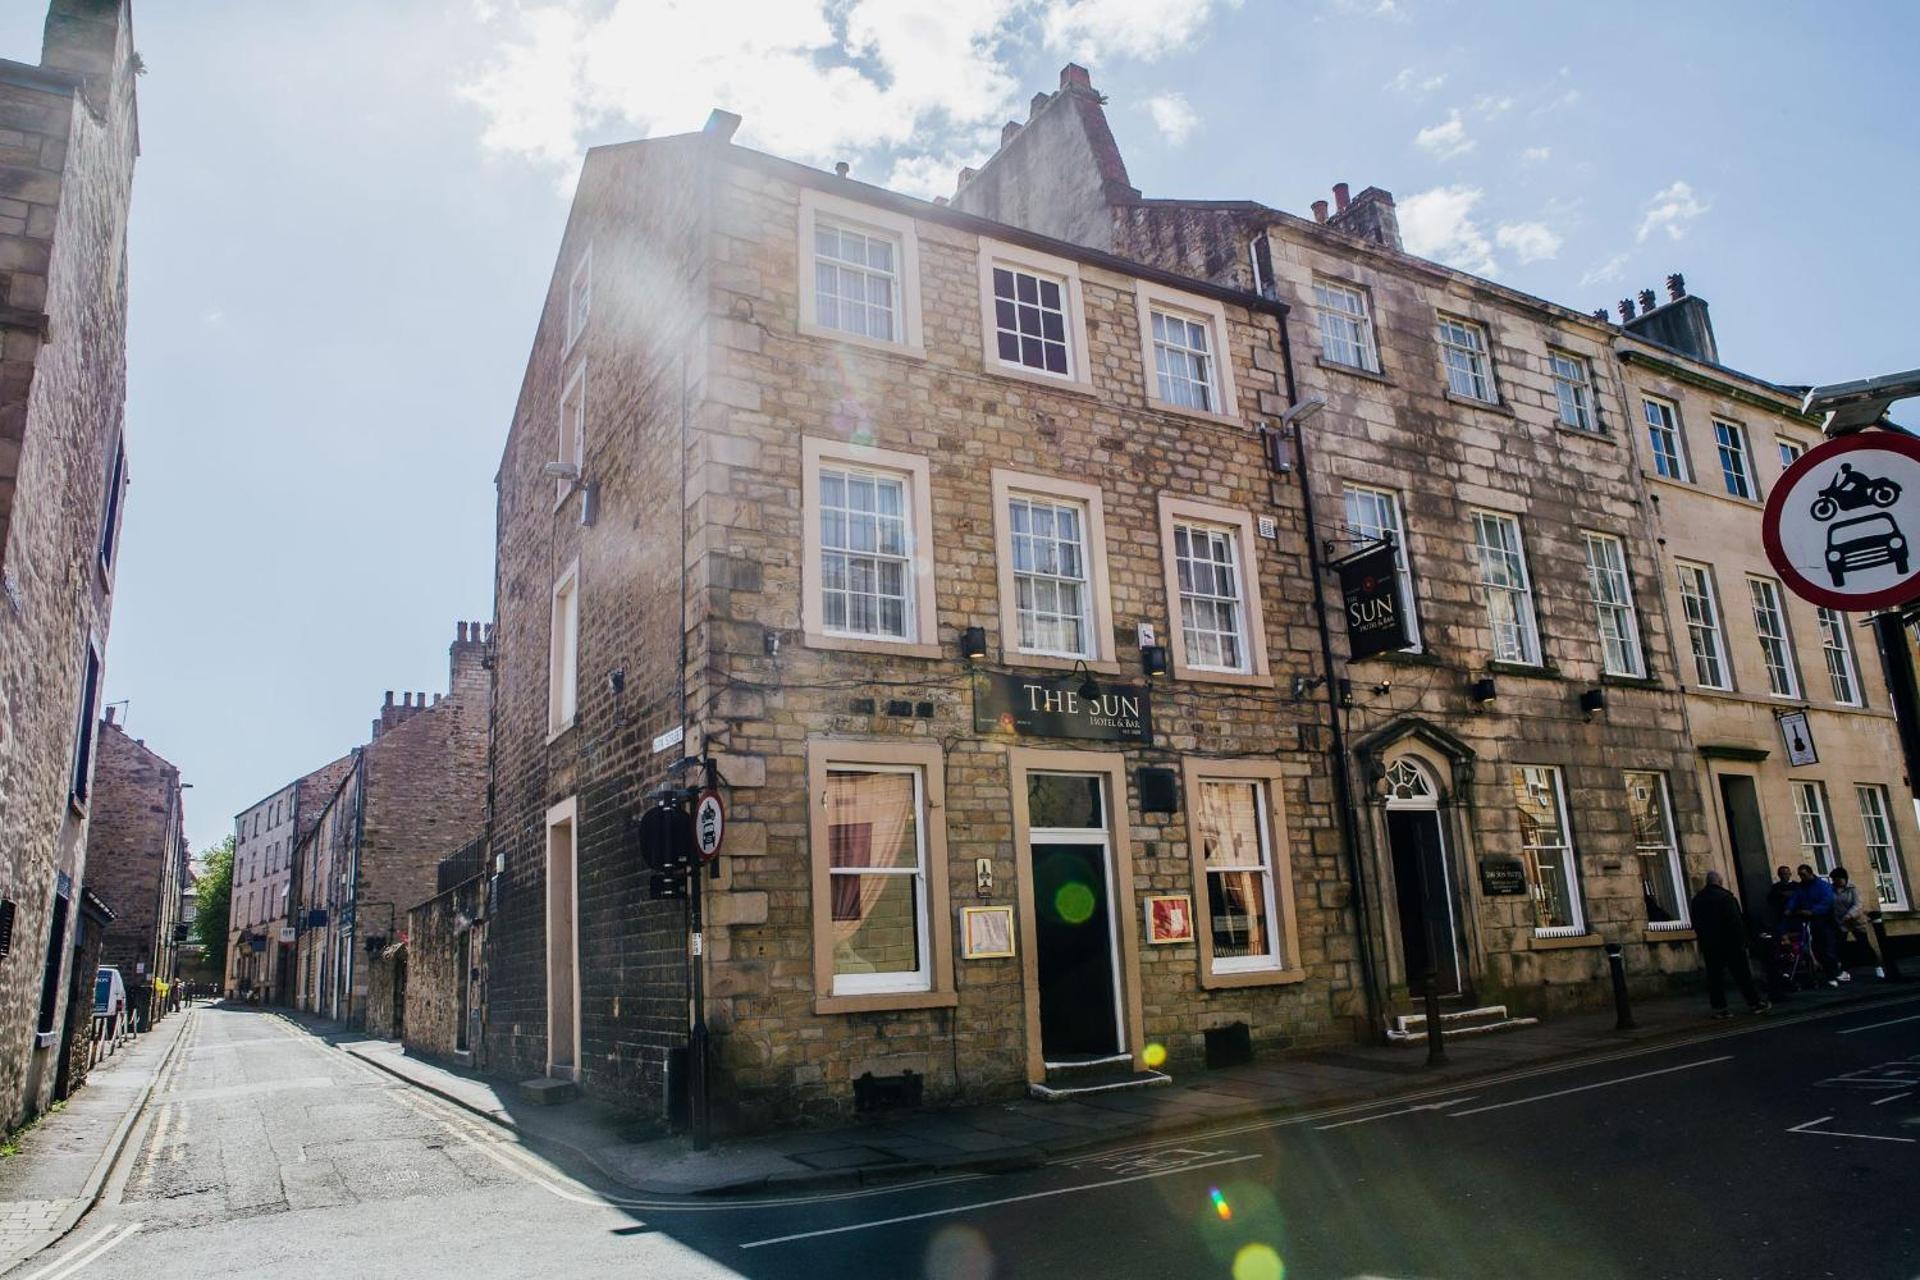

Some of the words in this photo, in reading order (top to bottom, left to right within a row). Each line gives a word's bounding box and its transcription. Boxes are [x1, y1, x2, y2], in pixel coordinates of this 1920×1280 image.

[1350, 594, 1393, 627] SUN
[1023, 684, 1079, 714] THE
[1089, 694, 1140, 719] SUN
[1089, 716, 1117, 727] HOTEL
[1117, 718, 1125, 728] &
[1125, 718, 1141, 728] BAR
